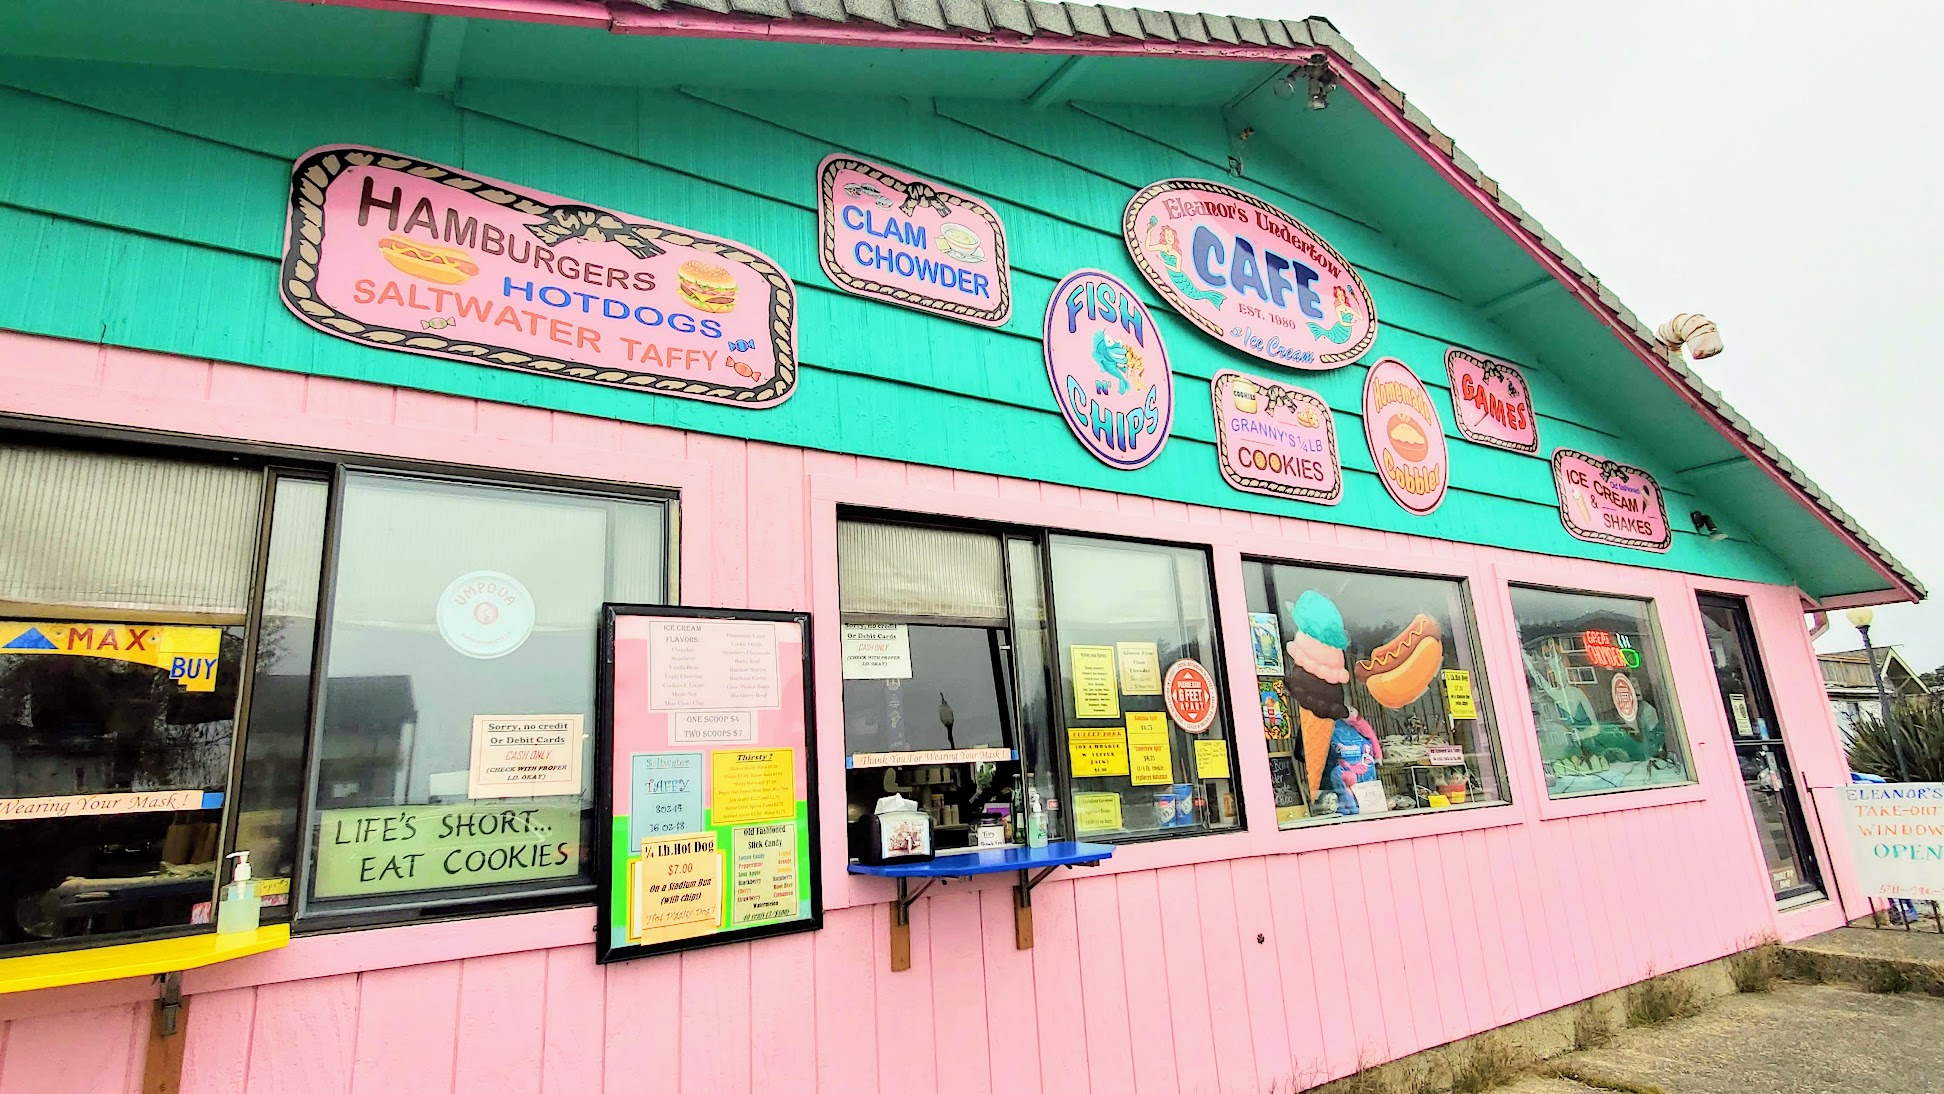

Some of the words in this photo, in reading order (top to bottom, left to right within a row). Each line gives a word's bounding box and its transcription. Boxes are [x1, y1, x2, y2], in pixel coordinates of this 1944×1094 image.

[358, 176, 656, 292] HAMBURGERS
[842, 205, 927, 249] CLAM
[1161, 198, 1249, 224] Eleanor's
[1254, 210, 1342, 280] Undertow
[855, 240, 990, 299] CHOWDER
[1192, 225, 1324, 321] CAFE
[503, 276, 723, 339] HOTDOGS
[1065, 282, 1144, 349] FISH
[1238, 303, 1266, 322] EST.
[1269, 313, 1296, 330] 1980
[353, 279, 601, 353] SALTWATER
[620, 337, 718, 372] TAFFY
[1244, 327, 1265, 352] Ice
[1266, 336, 1316, 364] Cream
[1372, 376, 1433, 427] Homemade
[1461, 373, 1527, 431] GAMES
[1066, 374, 1158, 453] CHIPS
[1231, 418, 1296, 448] GRANNY'S
[1309, 439, 1323, 452] LB
[1238, 446, 1324, 482] COOKIES
[1383, 447, 1440, 496] Cobbler
[1566, 469, 1589, 489] ICE
[1593, 480, 1639, 513] CREAM
[1590, 494, 1599, 509] &
[1603, 513, 1653, 536] SHAKES
[67, 627, 150, 651] MAX
[859, 643, 874, 651] CASH
[874, 643, 889, 651] ONLY
[170, 656, 217, 680] BUY
[1179, 689, 1184, 702] 6
[1185, 689, 1203, 702] FEET
[1180, 701, 1204, 711] APART
[488, 723, 521, 731] Sorry,
[538, 722, 568, 730] credit
[684, 730, 701, 738] TWO
[506, 736, 534, 744] Debit
[505, 750, 529, 760] CASH
[530, 750, 552, 760] ONLY
[861, 755, 888, 766] Thank
[889, 754, 906, 763] You
[908, 755, 922, 763] For
[924, 751, 957, 763] Wearing
[959, 751, 978, 760] Your
[645, 778, 690, 793] TAFFY
[1845, 786, 1944, 801] ELEANOR'S
[77, 796, 122, 810] Your
[1855, 805, 1938, 818] TAKE-OUT
[335, 811, 417, 845] LIFE'S
[438, 808, 552, 839] SHORT...
[744, 828, 755, 836] Old
[756, 825, 786, 835] Fashioned
[1857, 824, 1944, 837] WINDOW
[694, 840, 714, 853] Dog
[764, 839, 782, 848] Candy
[1874, 842, 1944, 861] OPEN
[359, 853, 424, 883] EAT
[443, 842, 569, 875] COOKIES
[668, 863, 693, 876] $7.00
[668, 881, 697, 891] Stadium
[697, 878, 712, 887] Bun
[660, 895, 679, 906] (with
[681, 892, 702, 902] chips)
